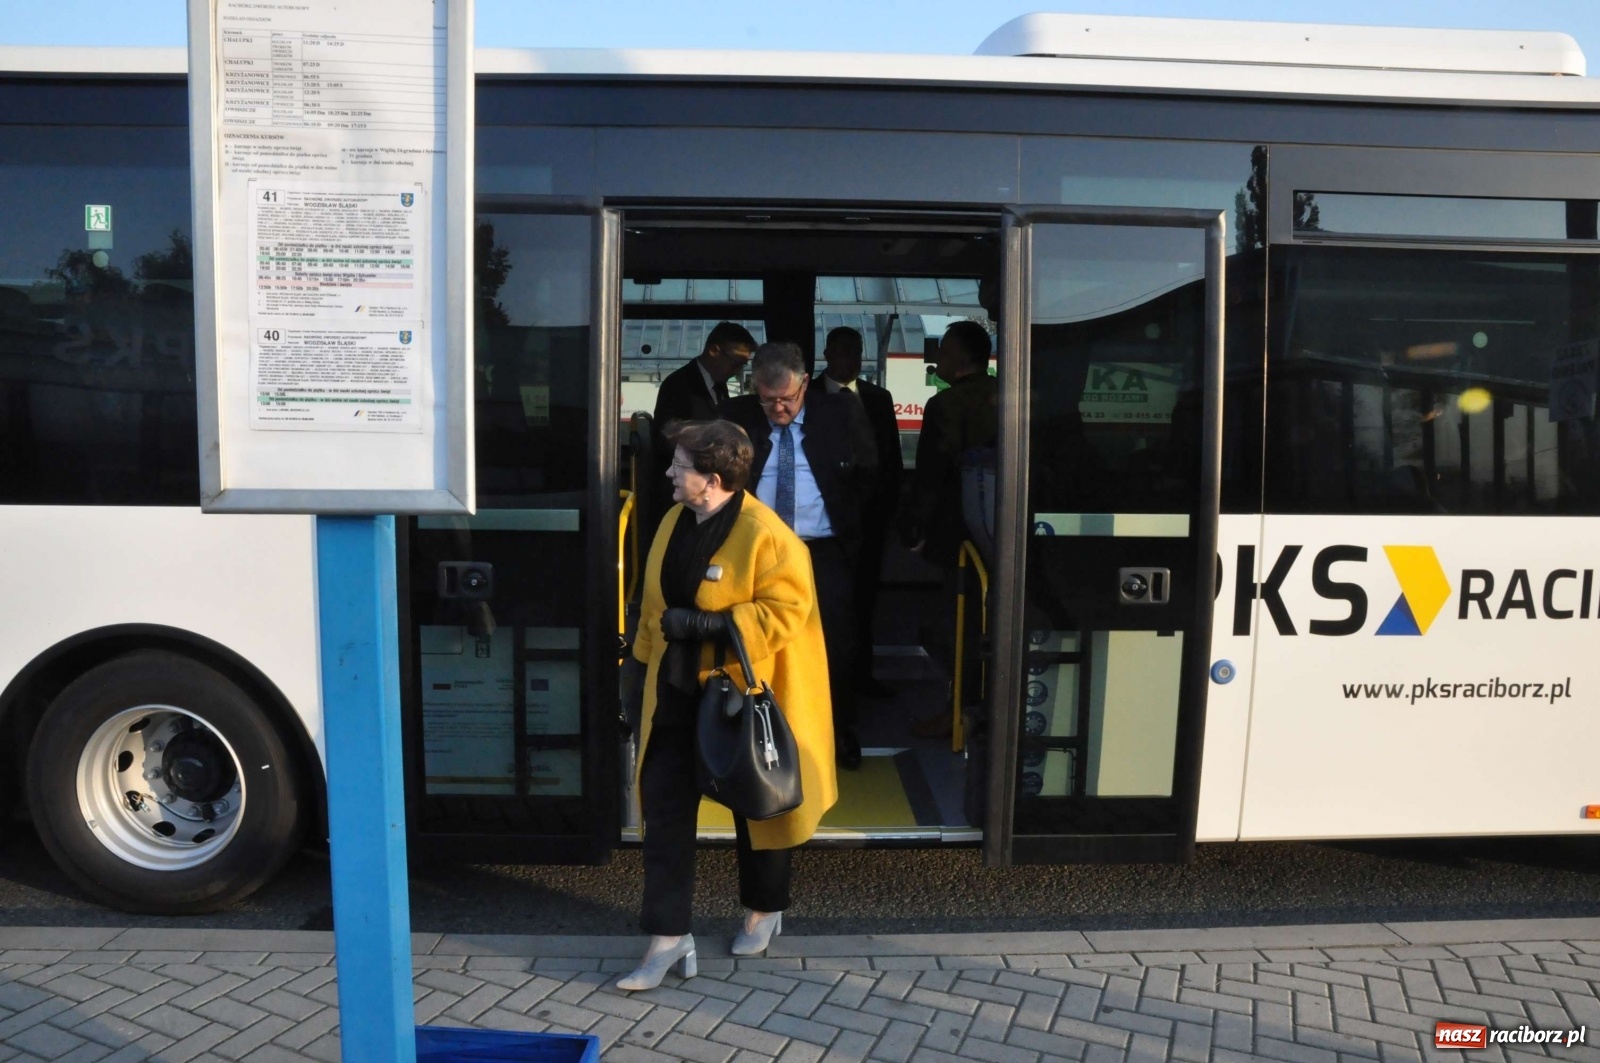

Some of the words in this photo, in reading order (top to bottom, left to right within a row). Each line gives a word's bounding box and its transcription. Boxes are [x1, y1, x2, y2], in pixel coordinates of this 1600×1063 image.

[263, 191, 278, 202] 41
[264, 330, 279, 341] 40
[894, 403, 924, 415] 24h
[1214, 544, 1368, 637] KS
[1458, 568, 1600, 620] RACI
[1342, 677, 1572, 705] www.pksraciborz.pl
